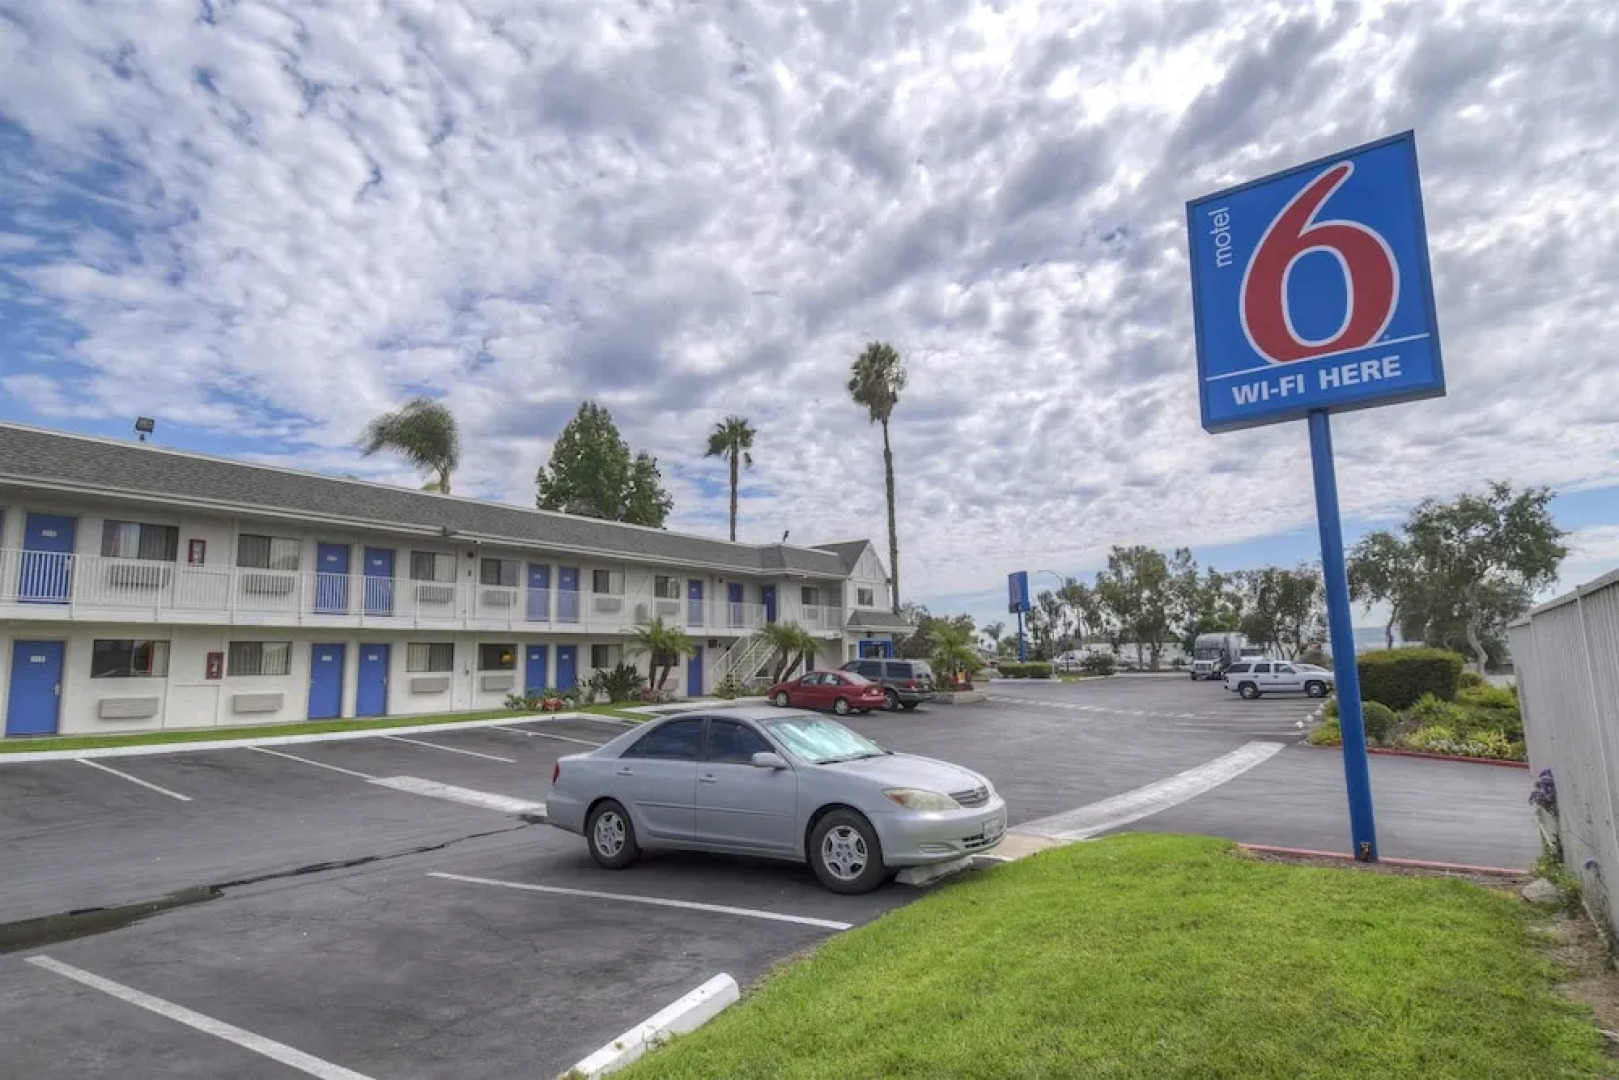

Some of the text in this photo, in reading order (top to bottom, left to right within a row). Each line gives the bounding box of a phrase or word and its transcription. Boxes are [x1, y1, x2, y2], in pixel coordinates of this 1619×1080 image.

[1209, 207, 1232, 268] motel
[1239, 160, 1400, 364] 6
[1232, 354, 1401, 406] WI-FI HERE
